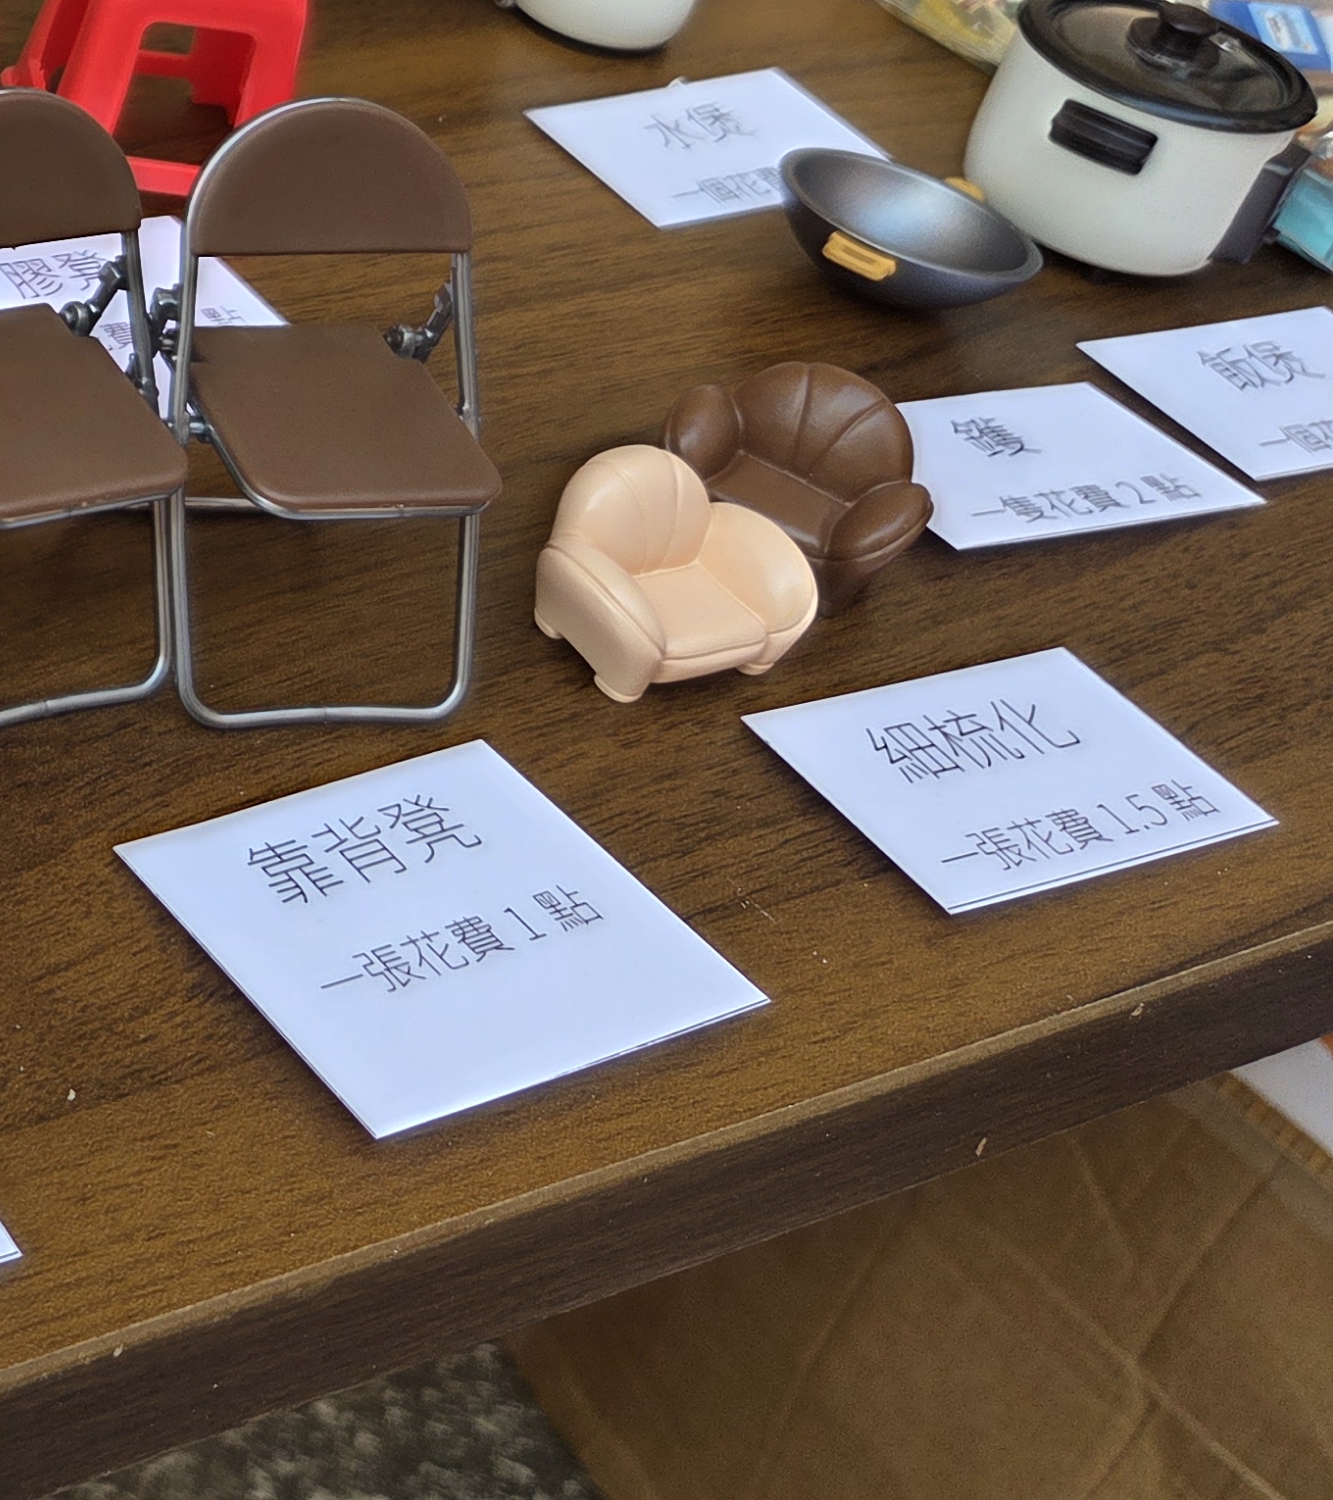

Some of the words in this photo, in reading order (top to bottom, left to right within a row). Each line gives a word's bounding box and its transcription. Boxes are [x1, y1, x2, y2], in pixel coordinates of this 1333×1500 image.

[643, 101, 759, 150] 水煲
[1197, 340, 1327, 392] 飯煲
[1114, 480, 1157, 506] 2
[1139, 472, 1204, 503] 點
[865, 698, 1081, 785] 細梳化
[247, 793, 483, 904] 靠背凳
[940, 807, 1115, 871] 一張花費
[1096, 793, 1170, 835] 1.5
[1151, 778, 1221, 821] 點
[320, 915, 516, 993] 一張花費
[503, 907, 547, 941] 1
[532, 884, 605, 932] 點
